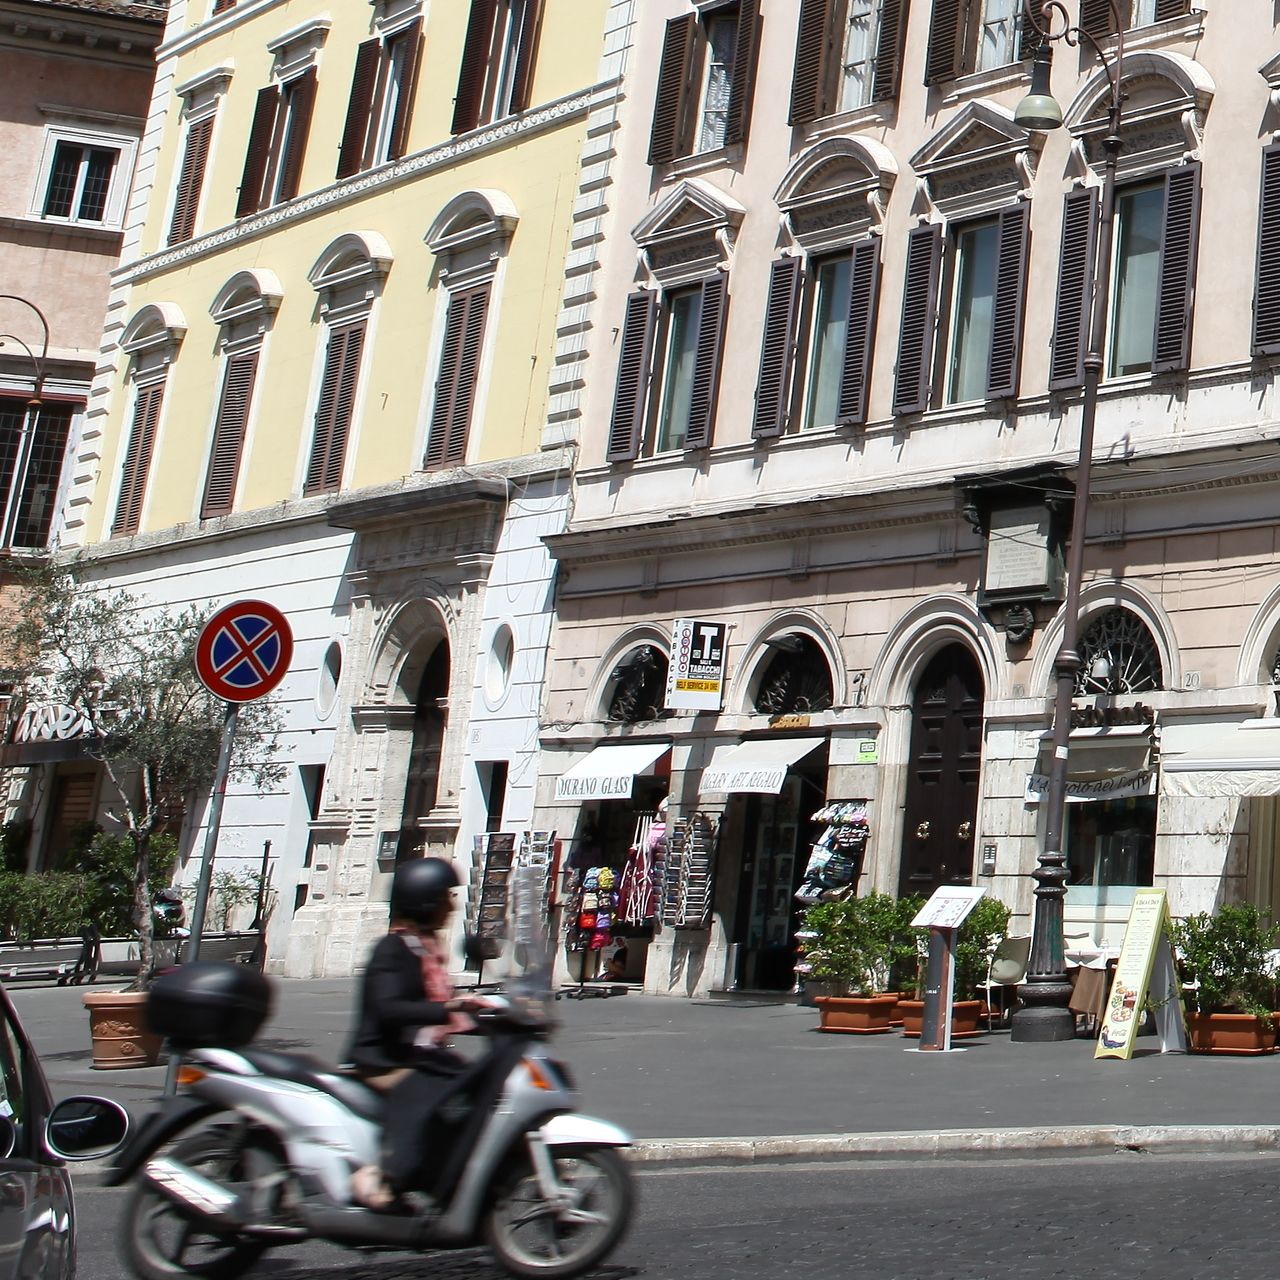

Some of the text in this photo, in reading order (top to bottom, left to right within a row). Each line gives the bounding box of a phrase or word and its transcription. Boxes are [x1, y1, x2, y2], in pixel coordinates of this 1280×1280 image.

[700, 626, 719, 660] T
[666, 620, 680, 706] TABACCHI
[690, 665, 720, 674] TABACCHI
[676, 681, 687, 689] SELF
[687, 682, 704, 690] SERVICE
[1185, 670, 1200, 688] 20
[559, 775, 631, 796] MURANO GLASS
